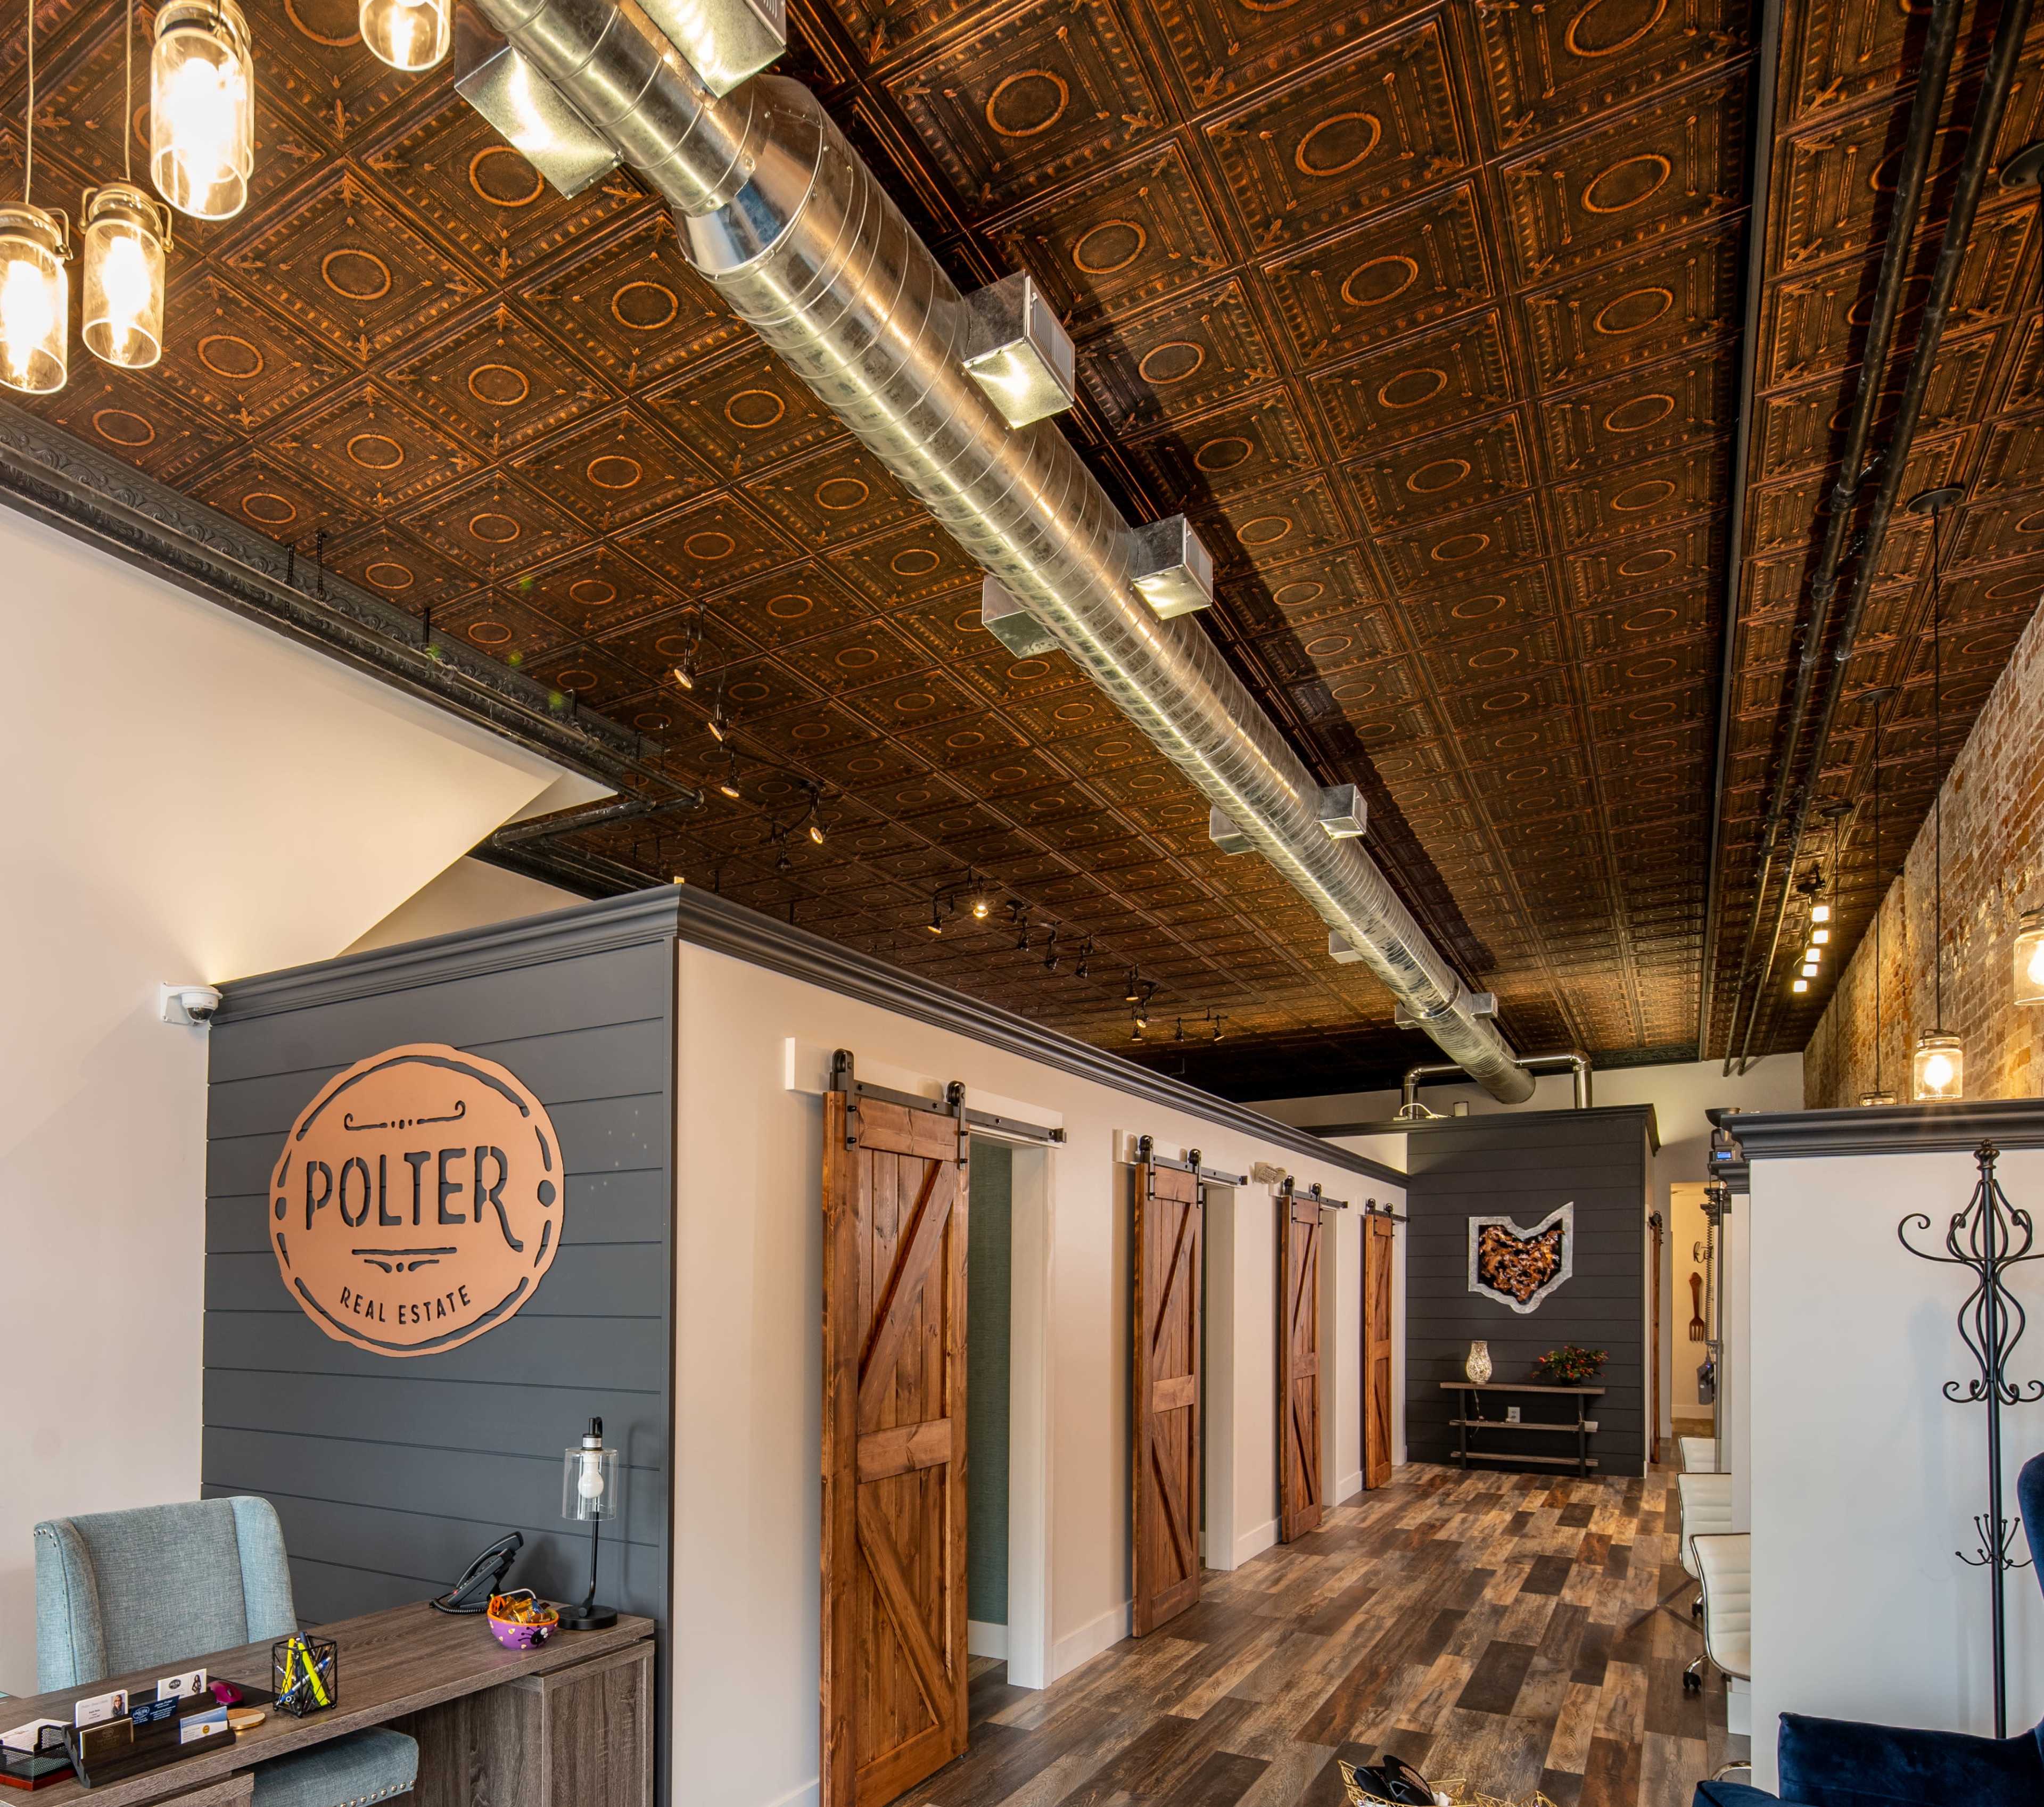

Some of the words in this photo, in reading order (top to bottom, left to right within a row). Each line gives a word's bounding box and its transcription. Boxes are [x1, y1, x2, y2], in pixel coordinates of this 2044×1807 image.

[306, 1145, 524, 1253] POLTER
[340, 1286, 385, 1323] REAL
[399, 1284, 471, 1325] ESTATE
